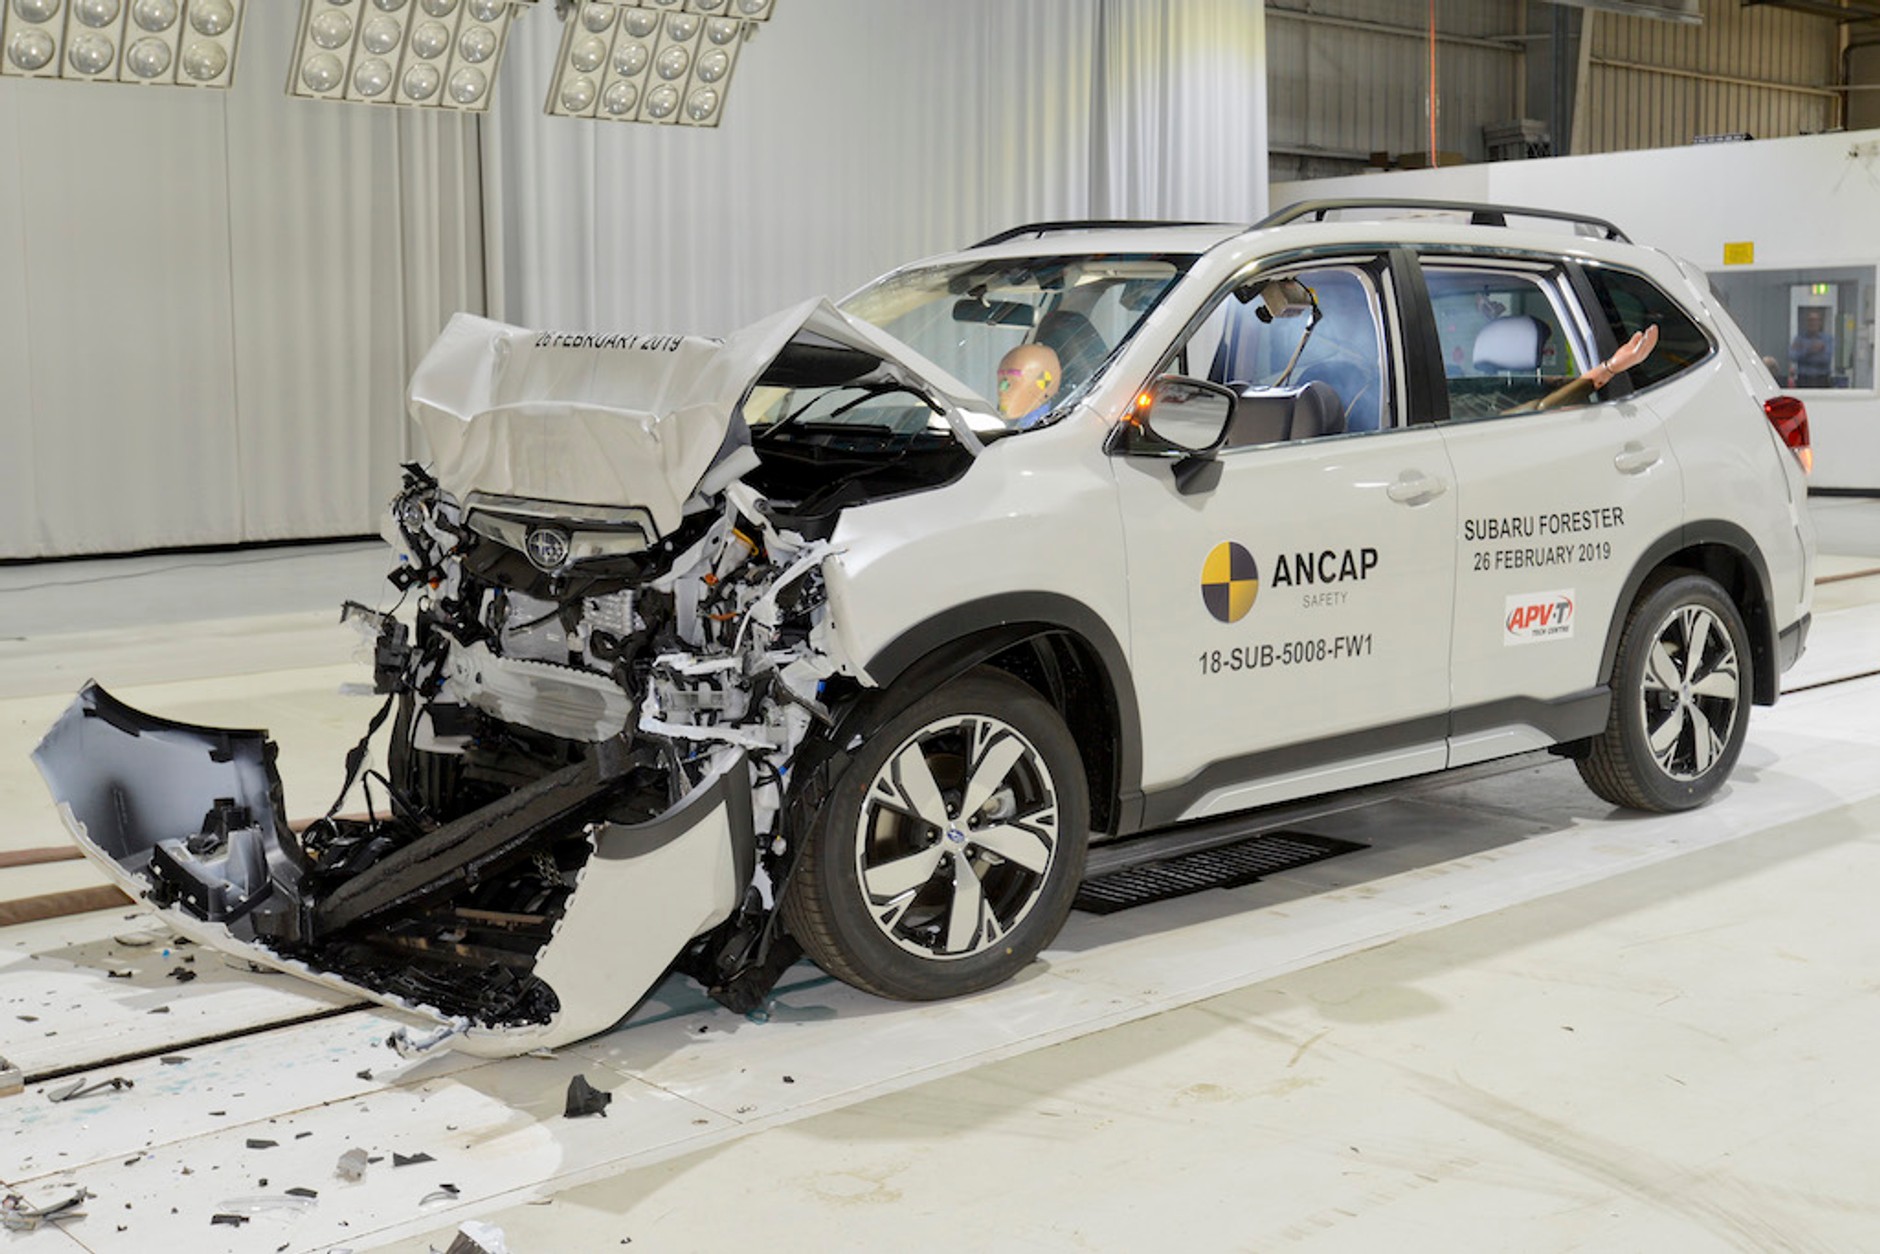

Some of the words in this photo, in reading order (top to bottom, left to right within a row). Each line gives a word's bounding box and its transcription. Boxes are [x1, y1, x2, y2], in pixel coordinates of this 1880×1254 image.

[640, 336, 684, 352] 2019
[1464, 516, 1534, 541] SUBARU
[1539, 506, 1625, 535] FORESTER
[1271, 547, 1379, 588] ANCAP
[1474, 552, 1491, 571] 26
[1495, 544, 1575, 570] FEBRUARY
[1578, 541, 1611, 562] 2019
[1302, 591, 1348, 609] SAFETY
[1199, 633, 1373, 675] 18-SUB-5008-FW1
